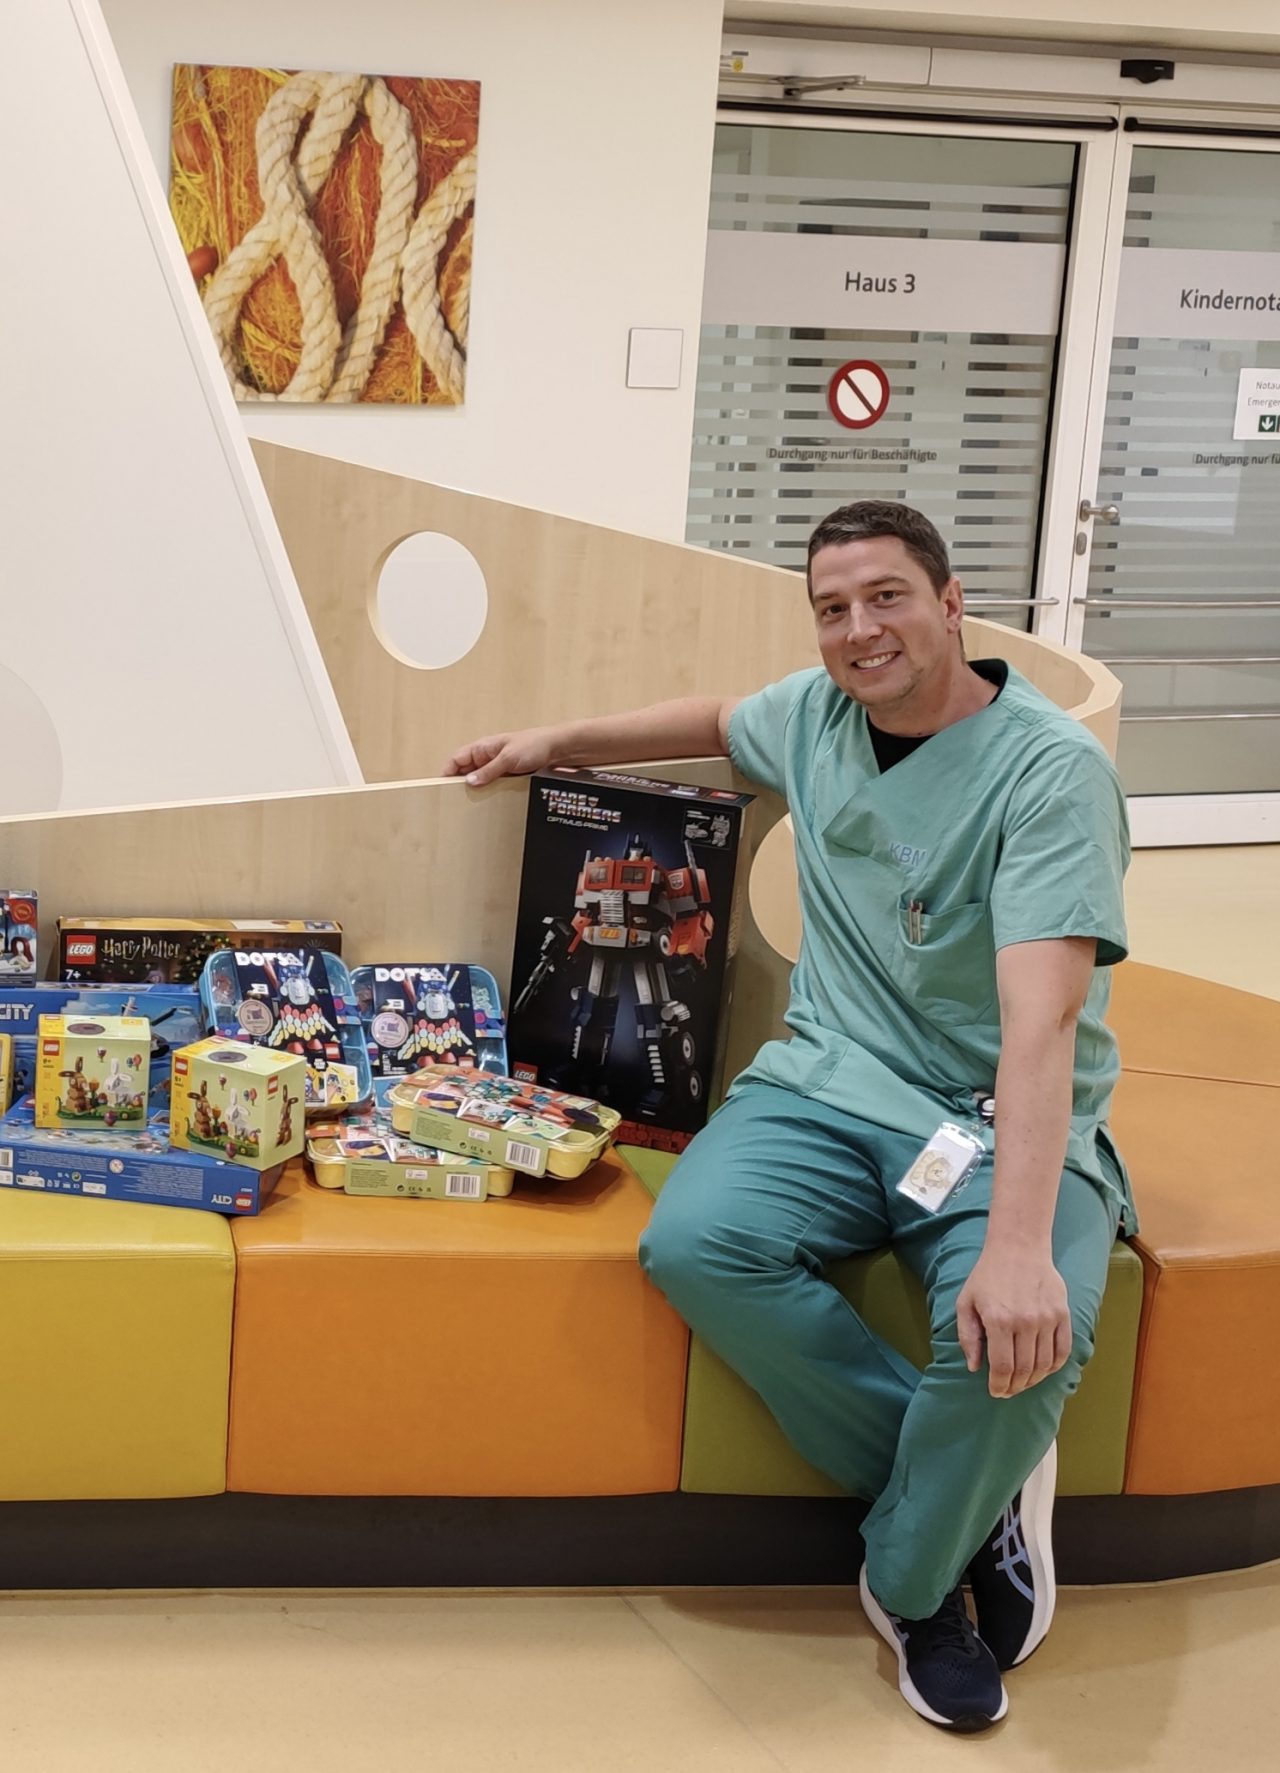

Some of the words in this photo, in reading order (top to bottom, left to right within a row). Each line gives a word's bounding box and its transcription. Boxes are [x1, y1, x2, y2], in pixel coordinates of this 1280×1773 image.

[844, 271, 898, 293] Haus
[903, 273, 916, 294] 3
[769, 447, 830, 462] Durchgang
[831, 450, 849, 460] nur
[852, 448, 869, 460] für
[871, 449, 937, 463] Beschäftigte
[1195, 453, 1249, 467] Durchgang
[1251, 456, 1269, 464] nur
[548, 800, 622, 823] FORMERS
[68, 944, 94, 956] LEGO
[101, 938, 141, 961] Harry
[141, 937, 181, 960] Potter
[65, 968, 81, 981] 7+
[514, 1070, 536, 1082] LEGO
